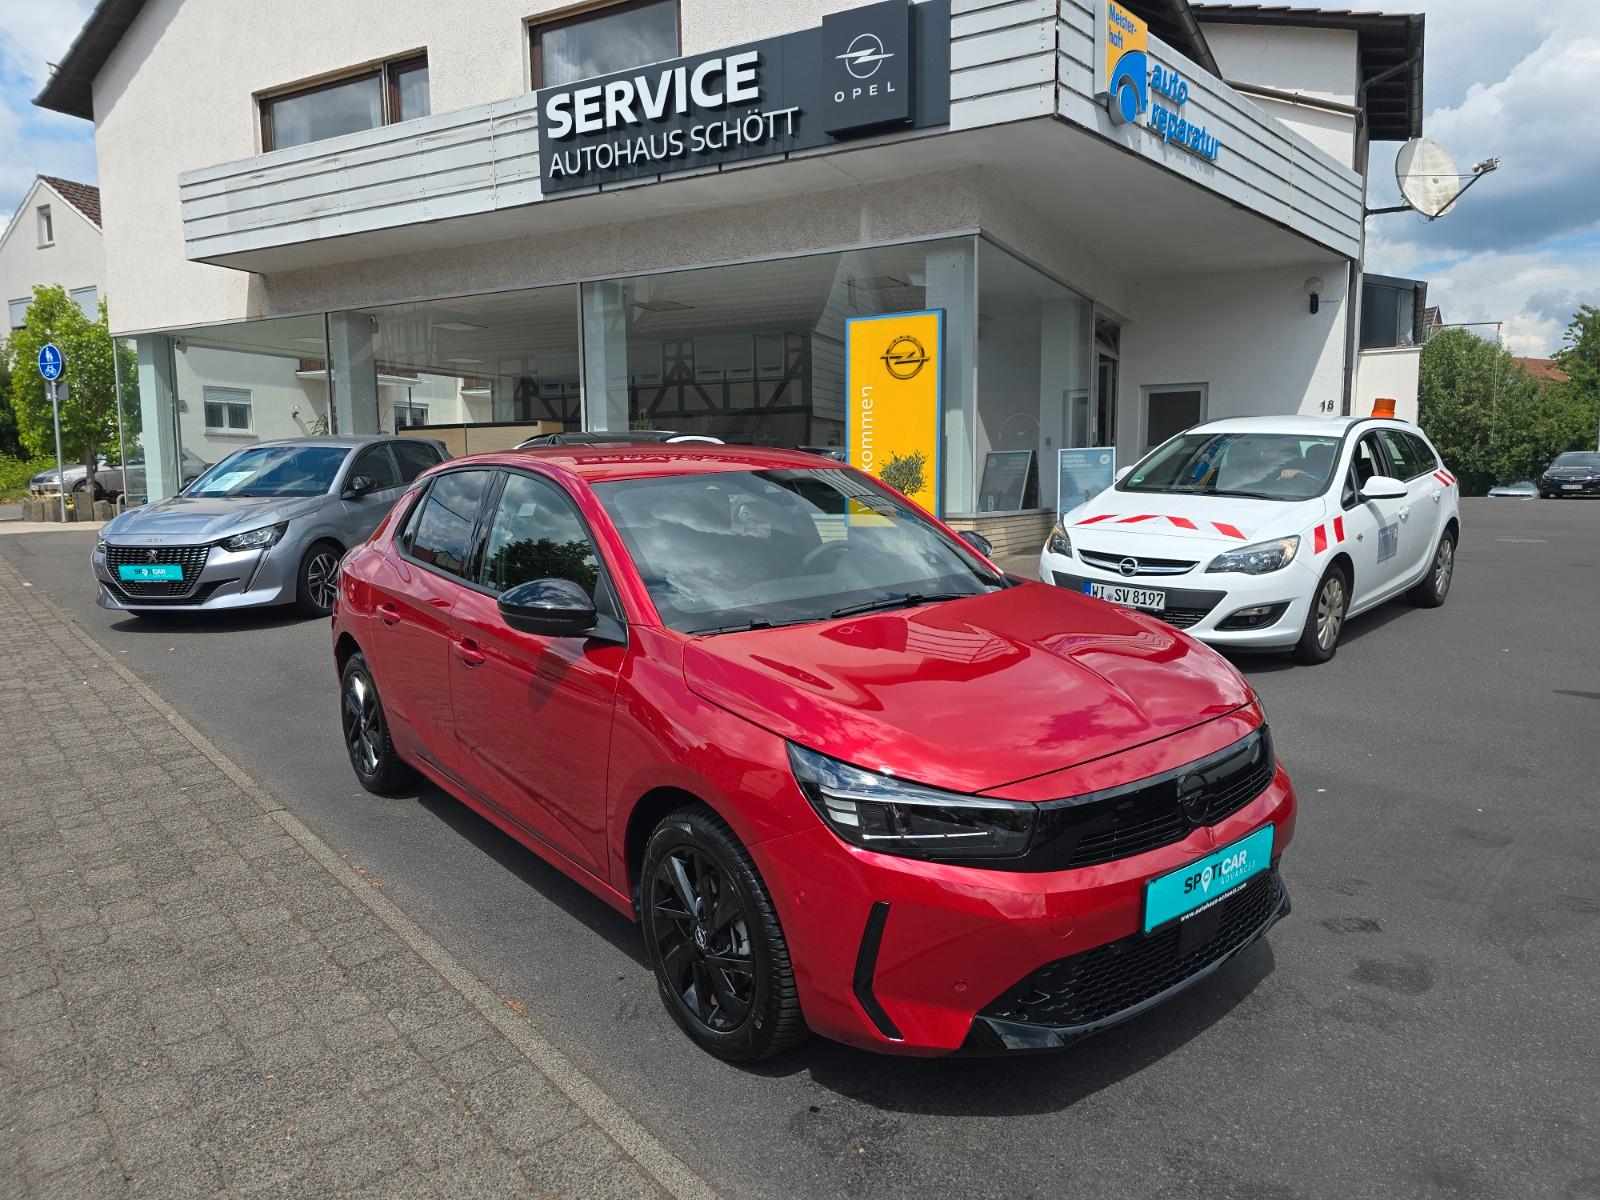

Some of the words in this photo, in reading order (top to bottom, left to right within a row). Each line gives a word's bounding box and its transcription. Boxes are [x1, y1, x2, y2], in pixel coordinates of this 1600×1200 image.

[545, 50, 759, 139] SERVICE
[834, 80, 896, 103] OPEL
[1151, 64, 1188, 106] auto
[548, 129, 683, 178] AUTOHAUS
[690, 106, 799, 153] SCHÖTT
[1151, 102, 1222, 161] reparatur
[1319, 399, 1334, 413] 18
[1114, 588, 1129, 602] SV
[1132, 590, 1164, 607] 8197
